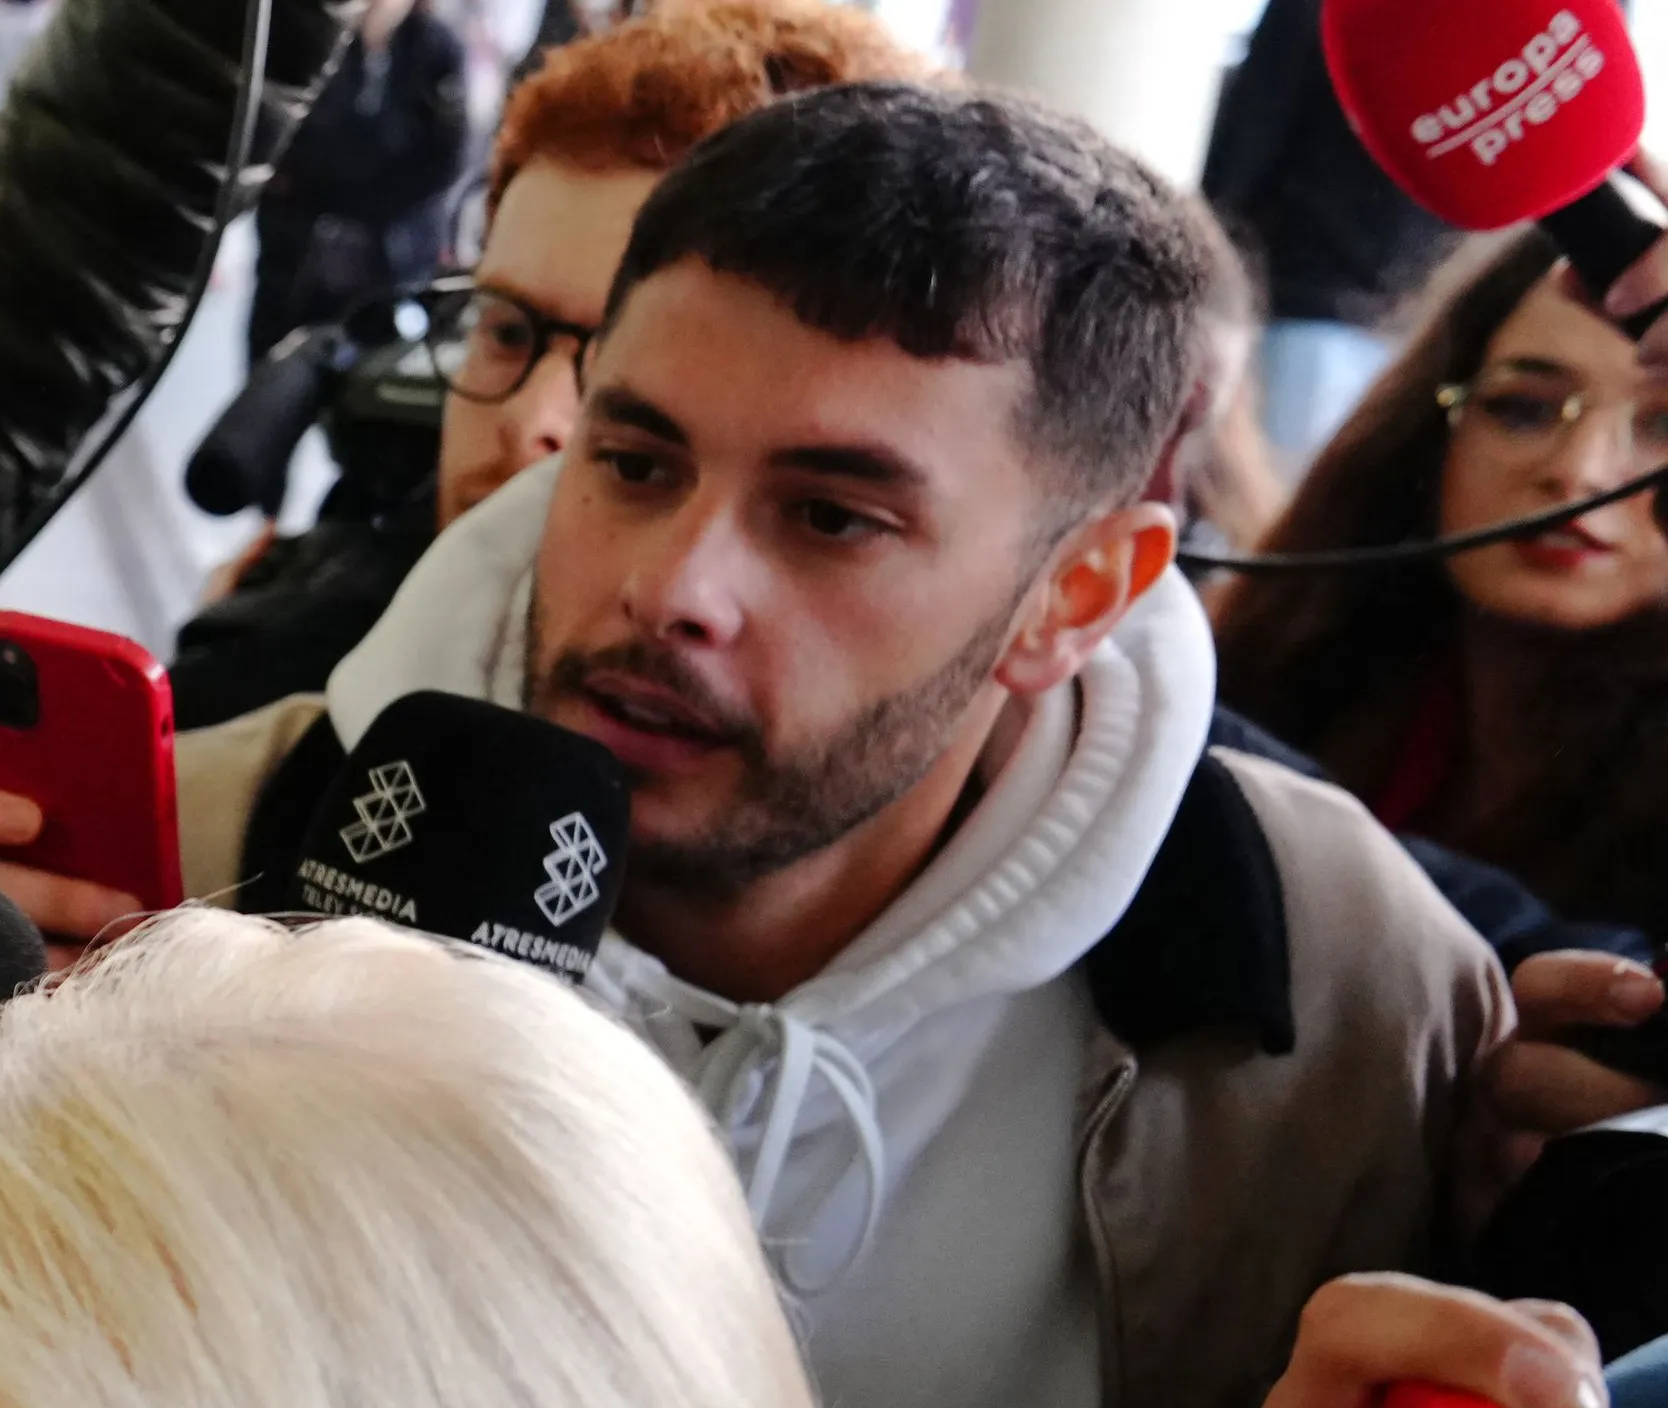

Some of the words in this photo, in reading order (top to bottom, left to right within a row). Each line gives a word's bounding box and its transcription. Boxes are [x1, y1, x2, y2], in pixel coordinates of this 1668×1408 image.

[1410, 9, 1581, 144] europa
[1470, 47, 1605, 165] press
[297, 858, 417, 922] ATRESMEDIA
